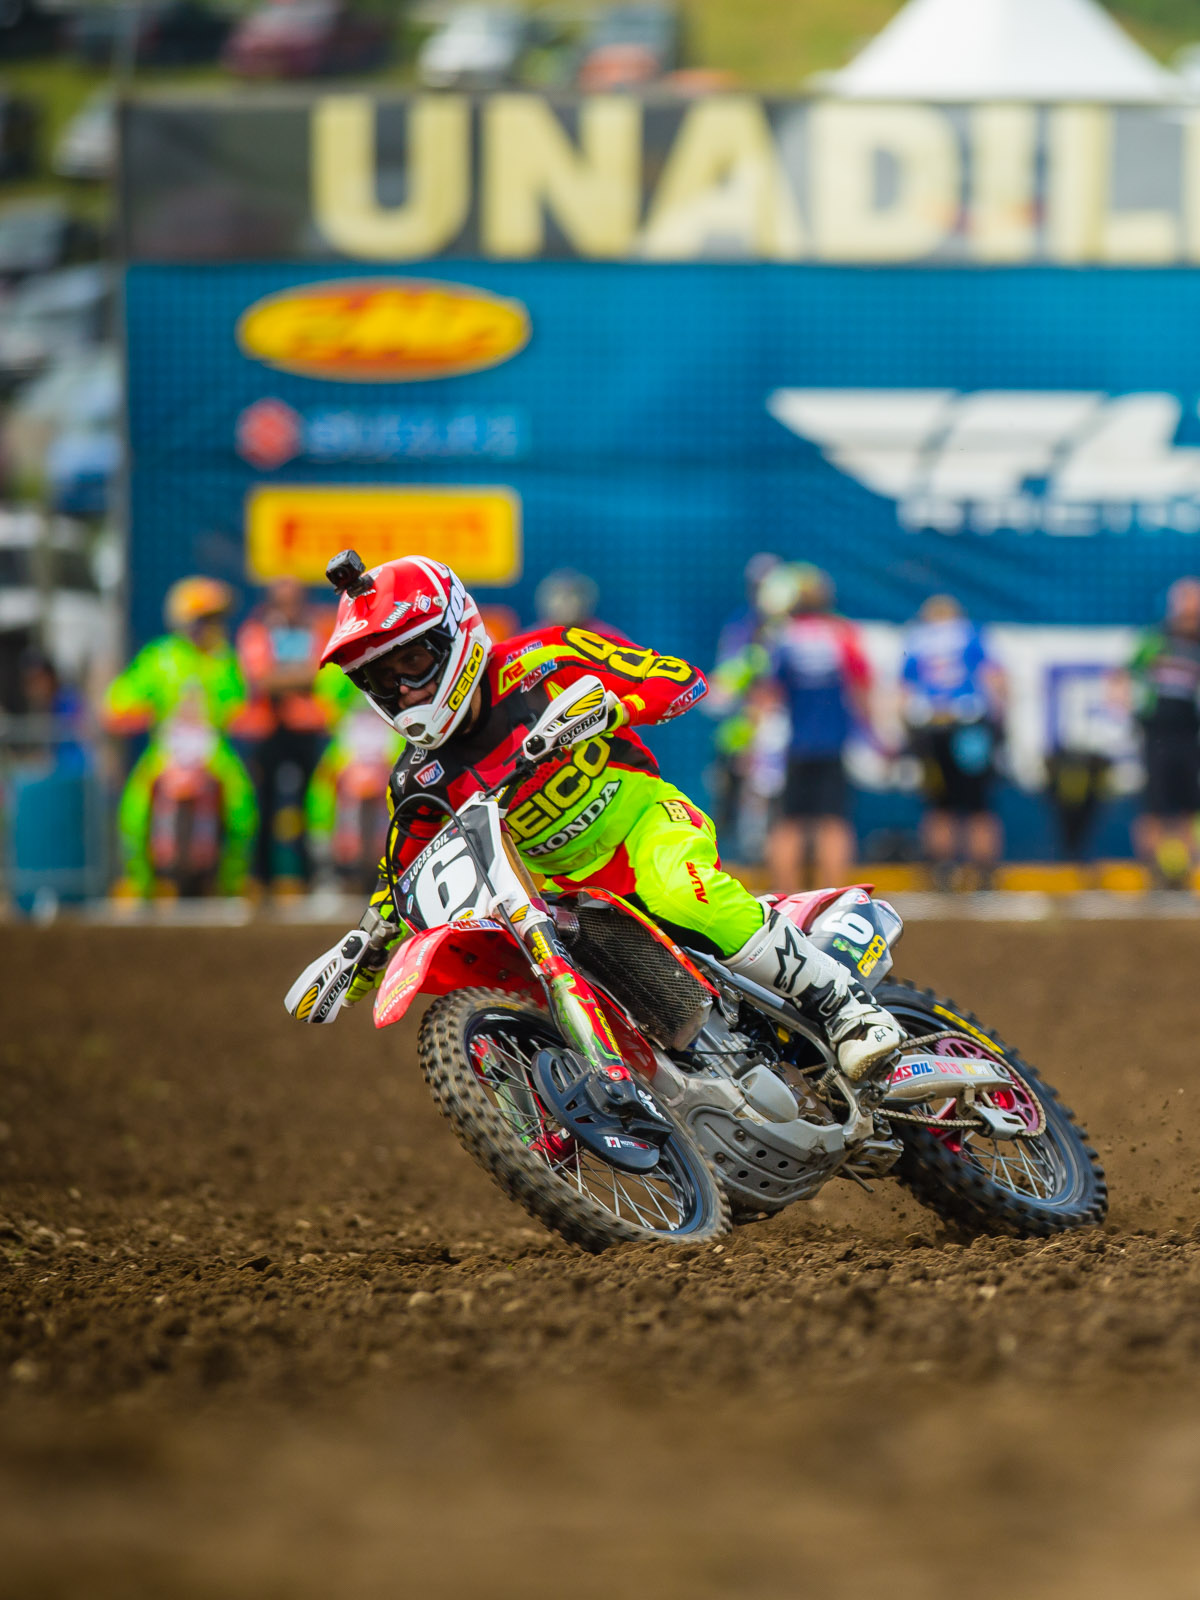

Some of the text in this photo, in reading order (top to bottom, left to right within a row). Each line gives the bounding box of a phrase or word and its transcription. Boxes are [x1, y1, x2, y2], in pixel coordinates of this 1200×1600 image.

[380, 601, 413, 629] GARMIN
[447, 641, 485, 713] GEICO
[520, 658, 558, 694] AMSOIL
[558, 714, 599, 746] CYCRA
[526, 779, 623, 857] HONDA
[408, 832, 450, 883] LUCAS OIL
[415, 836, 478, 930] 6
[450, 918, 502, 931] AMSOIL
[820, 910, 875, 945] 6
[856, 933, 888, 978] GEICO
[318, 973, 350, 1018] CYCRA
[379, 984, 416, 1022] HONDA
